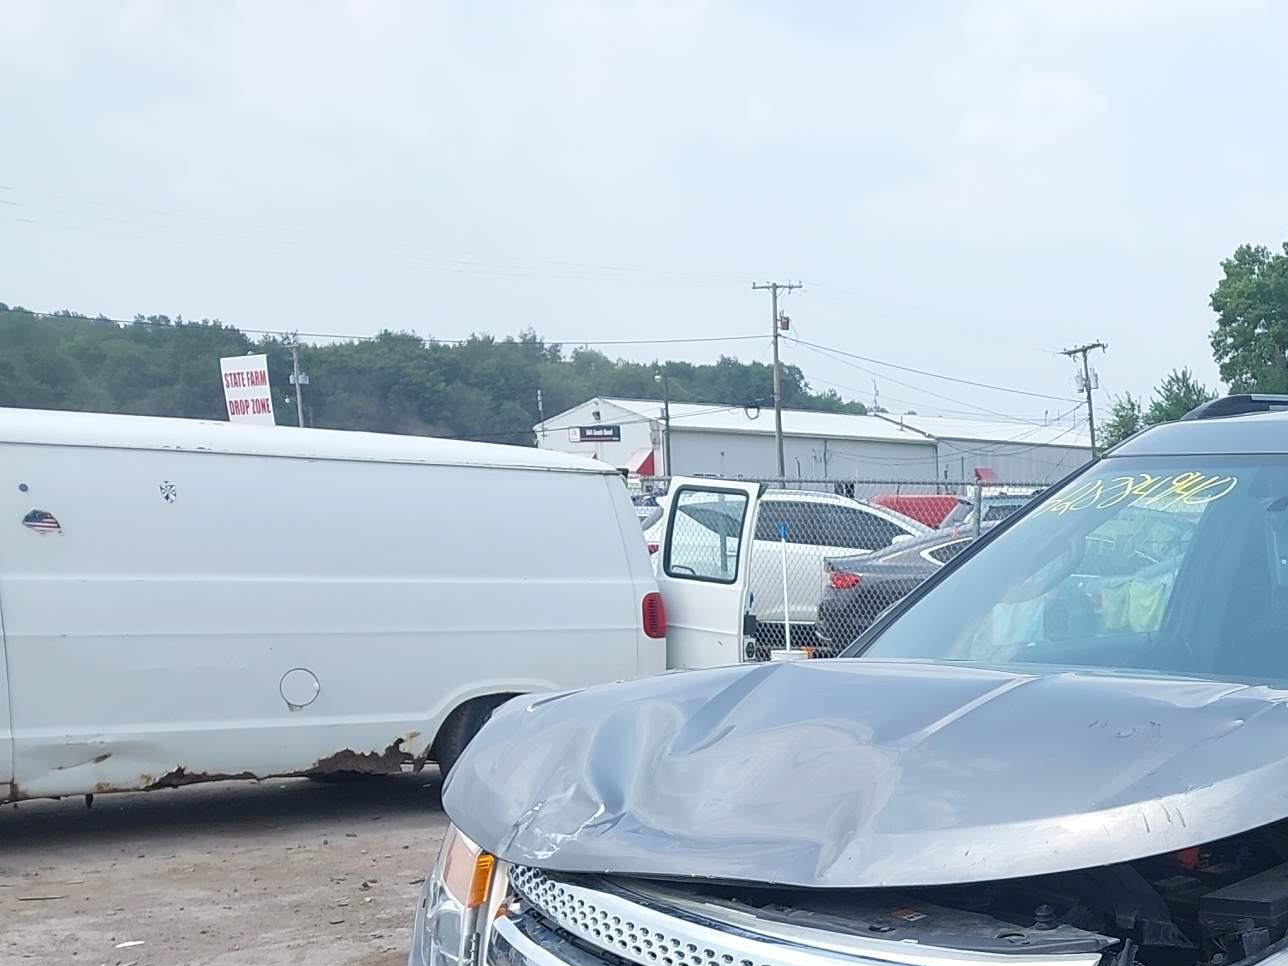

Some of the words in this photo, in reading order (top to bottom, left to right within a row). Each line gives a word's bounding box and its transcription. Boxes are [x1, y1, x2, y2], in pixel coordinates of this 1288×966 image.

[224, 372, 246, 388] STATE
[246, 370, 267, 387] FARM
[229, 400, 250, 415] DROP
[251, 398, 271, 414] ZONE
